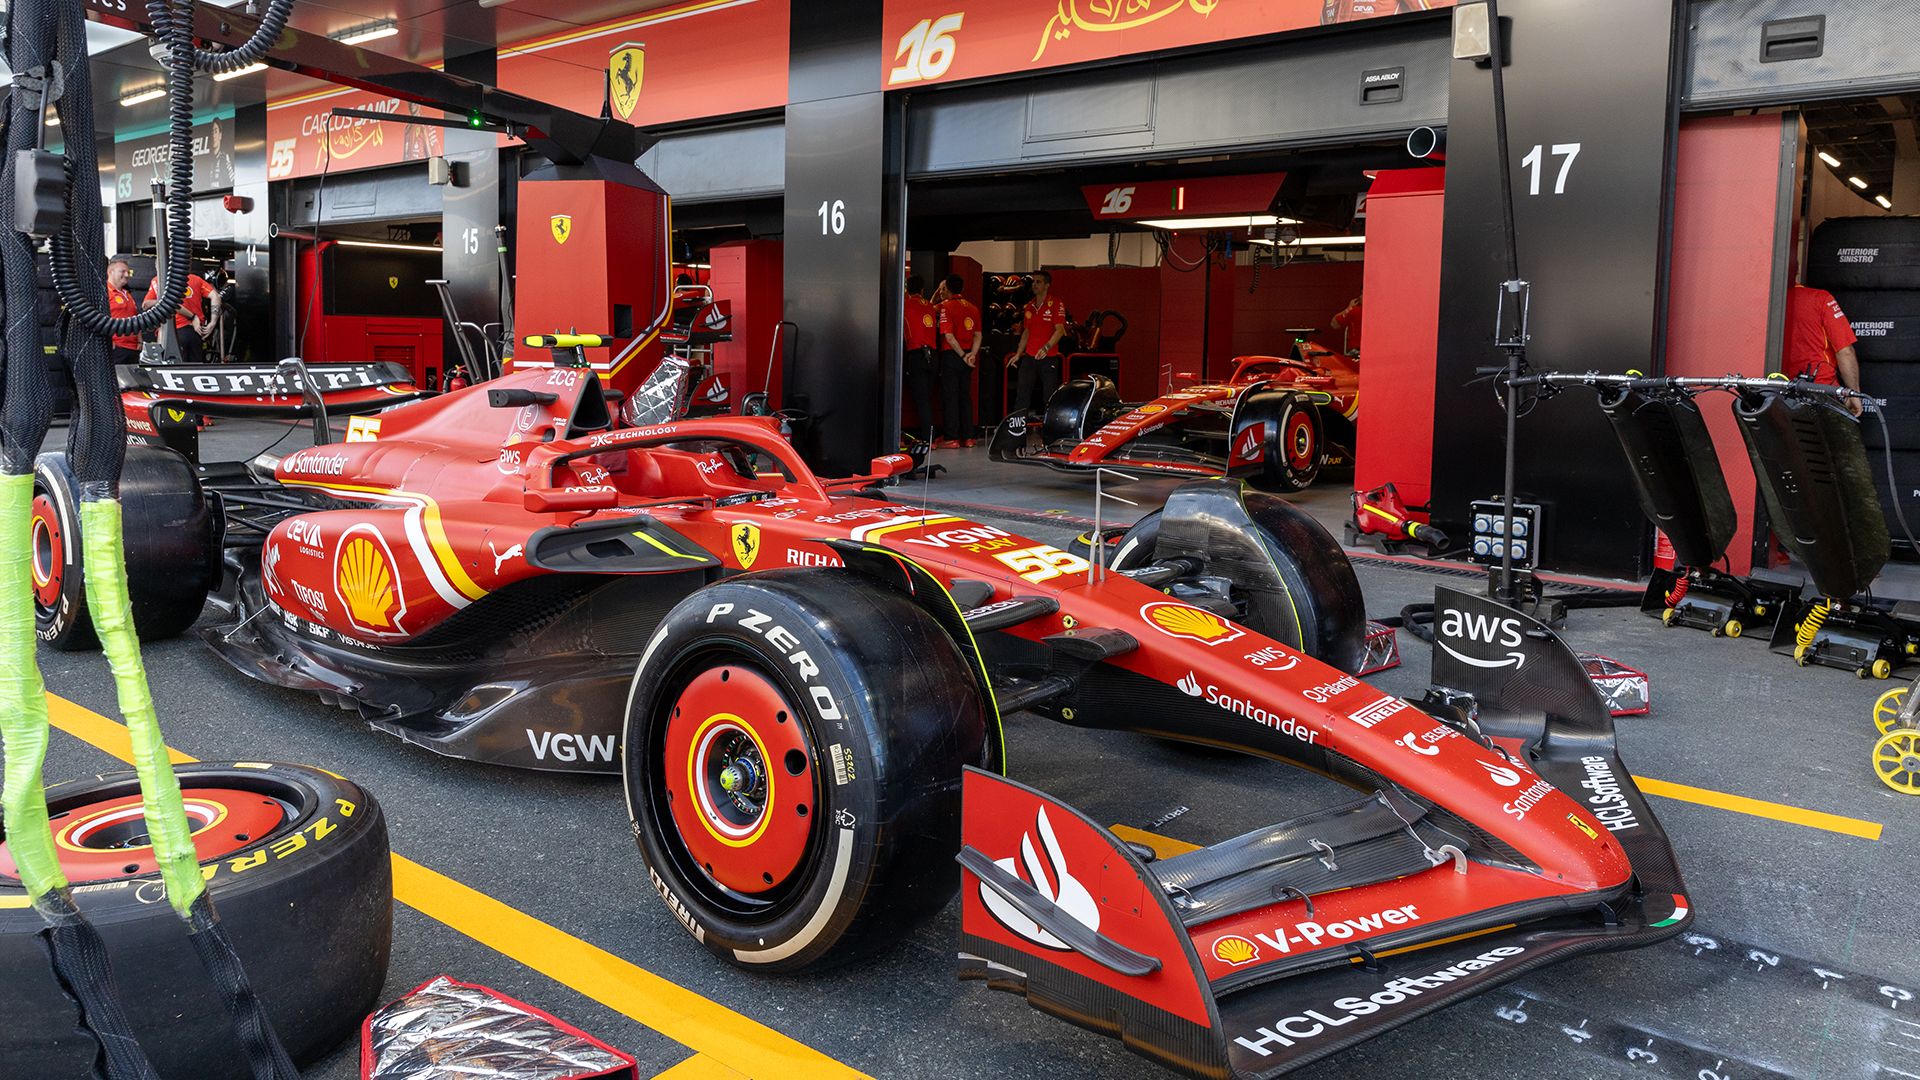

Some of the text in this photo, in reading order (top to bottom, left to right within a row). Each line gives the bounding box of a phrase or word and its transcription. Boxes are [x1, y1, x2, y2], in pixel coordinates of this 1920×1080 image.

[888, 12, 965, 85] 16
[1365, 72, 1400, 83] ASSA ABLOY
[302, 107, 353, 137] CARLOS
[131, 144, 169, 168] GEORGE
[269, 137, 297, 179] 55
[1521, 142, 1582, 196] 17
[118, 172, 133, 199] 63
[1100, 187, 1136, 214] 16
[818, 200, 846, 236] 16
[246, 244, 257, 266] 14
[462, 228, 479, 255] 15
[1837, 248, 1879, 256] ANTERIORE
[1839, 255, 1874, 263] SINISTRO
[1849, 321, 1895, 329] ANTERIORE
[1855, 329, 1887, 337] DESTRO
[156, 366, 376, 393] Ferrari
[547, 370, 578, 388] ZCG
[346, 415, 382, 442] 55
[615, 425, 678, 441] TECHNOLOGY
[294, 451, 349, 476] Santander
[499, 449, 521, 465] aws
[286, 519, 324, 549] CEVA
[904, 525, 1012, 548] VGW
[960, 537, 1019, 553] PLAY
[299, 546, 325, 560] LOGISTICS
[787, 548, 846, 567] RICHA
[991, 544, 1091, 585] 55
[291, 578, 329, 612] TIFOSI
[309, 623, 331, 638] SKF
[1440, 608, 1523, 648] aws
[706, 602, 842, 721] P ZERO
[1243, 646, 1287, 666] aws
[1312, 675, 1360, 698] Palantir
[1205, 683, 1319, 746] Santander
[1347, 695, 1409, 729] PIRELLI
[525, 728, 616, 762] VGW
[335, 798, 356, 817] P
[1502, 779, 1556, 821] Santande
[1152, 805, 1190, 828] FRONT
[1254, 904, 1421, 954] V-Power
[1233, 945, 1526, 1057] HCLSoftware
